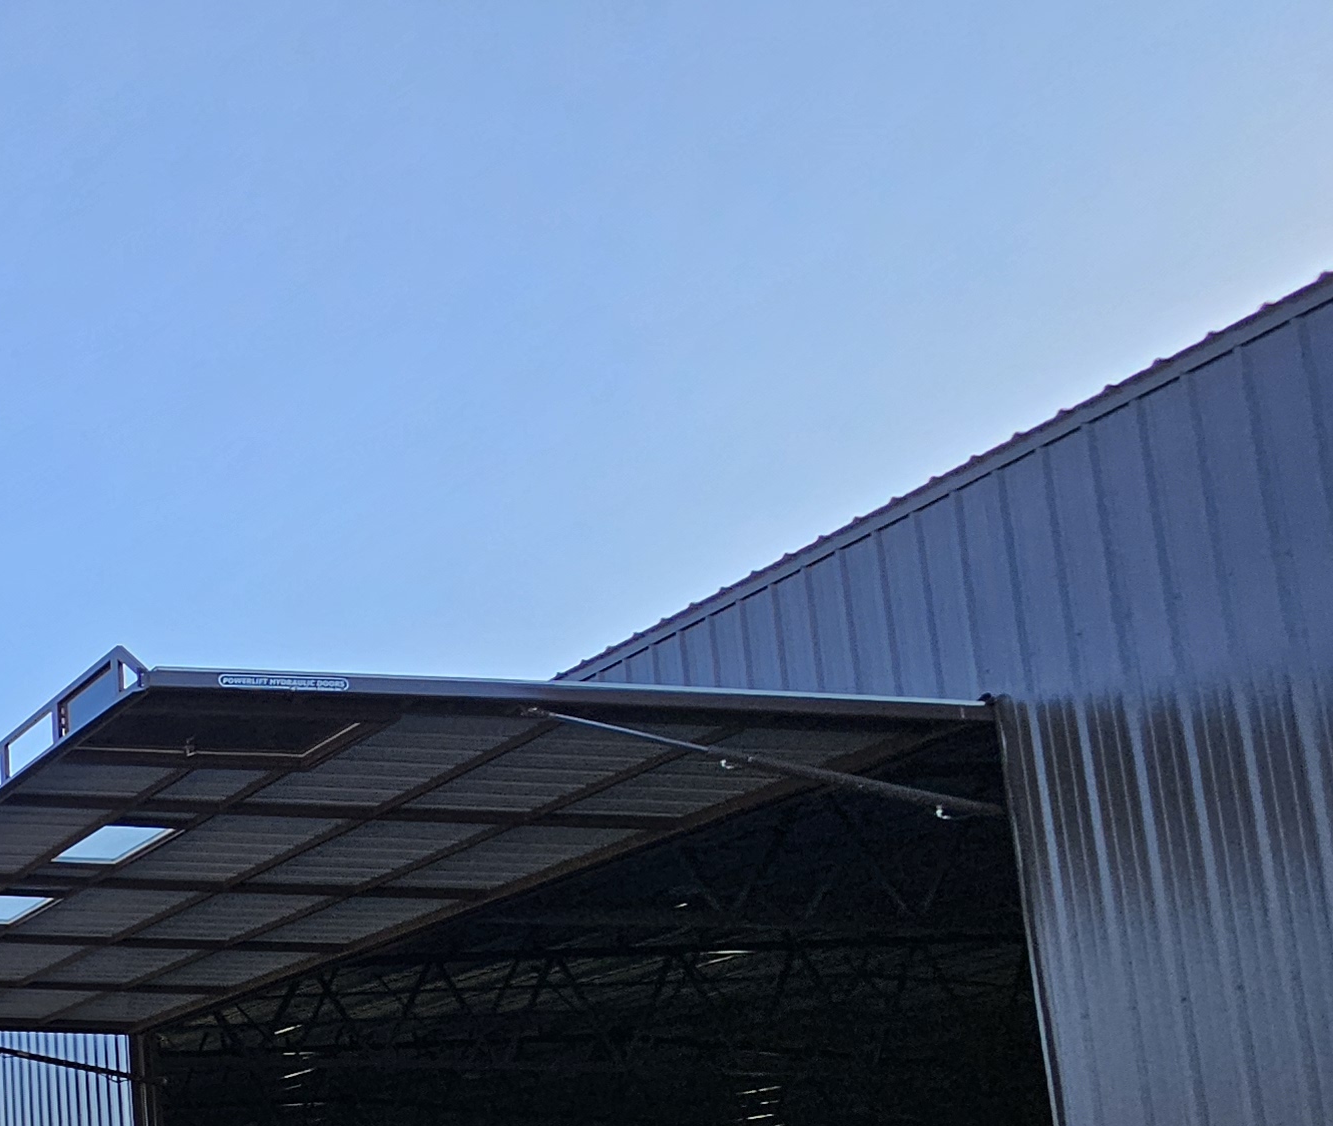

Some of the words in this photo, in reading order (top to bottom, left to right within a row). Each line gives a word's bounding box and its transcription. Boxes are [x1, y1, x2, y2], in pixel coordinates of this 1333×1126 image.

[222, 677, 268, 686] POWERLIFT
[269, 678, 316, 687] HYDRAULIC
[316, 679, 345, 688] DOORS
